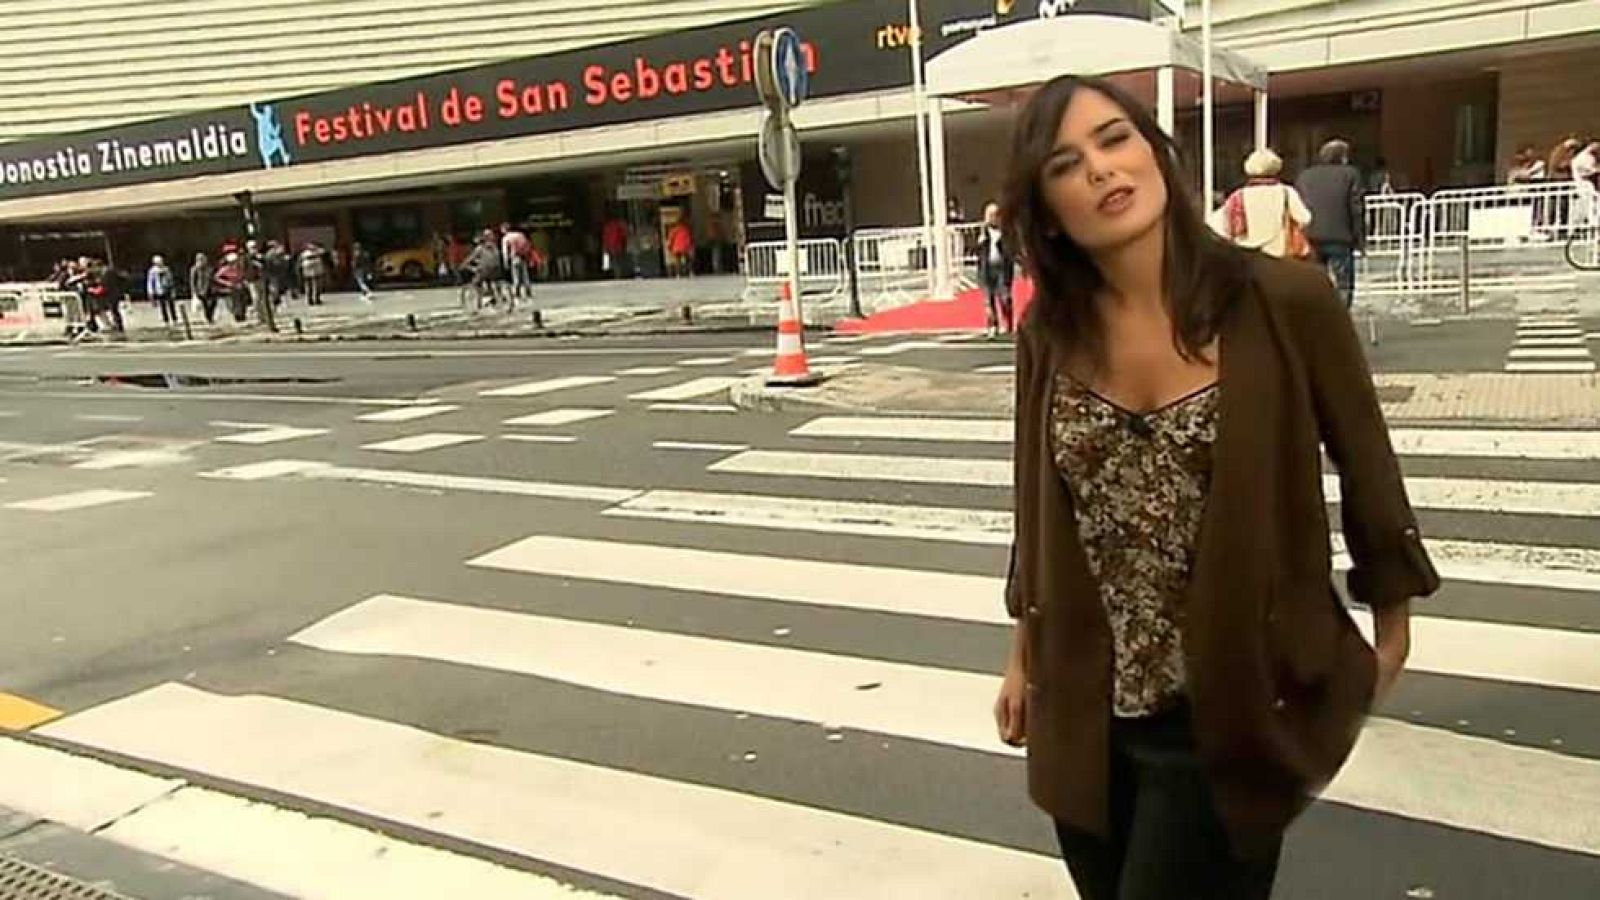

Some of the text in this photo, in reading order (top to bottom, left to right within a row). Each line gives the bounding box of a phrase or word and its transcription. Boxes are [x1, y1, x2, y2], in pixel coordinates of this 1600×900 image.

[295, 41, 818, 145] Festival de San Sebastin
[0, 124, 247, 184] onostia Zinemaldia
